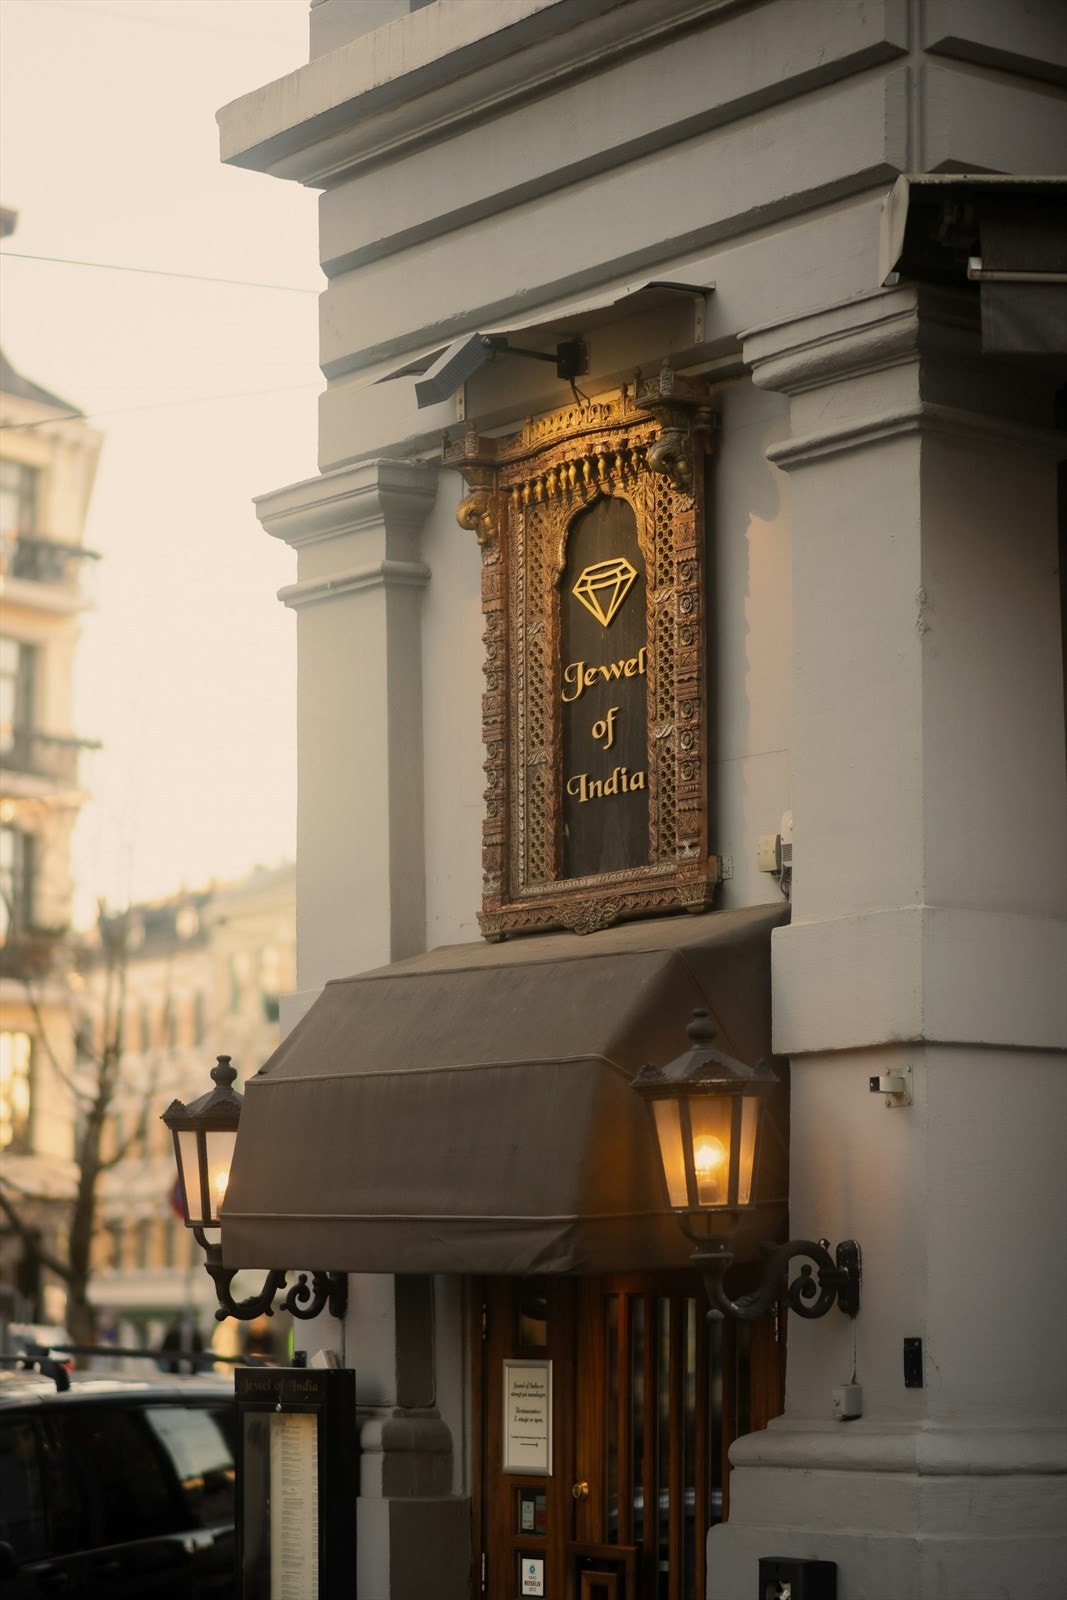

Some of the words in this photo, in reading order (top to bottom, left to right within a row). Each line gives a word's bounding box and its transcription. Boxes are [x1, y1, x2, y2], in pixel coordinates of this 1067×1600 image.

[561, 646, 647, 702] Jewel
[592, 706, 619, 750] of
[566, 766, 646, 803] India
[288, 1378, 319, 1392] India
